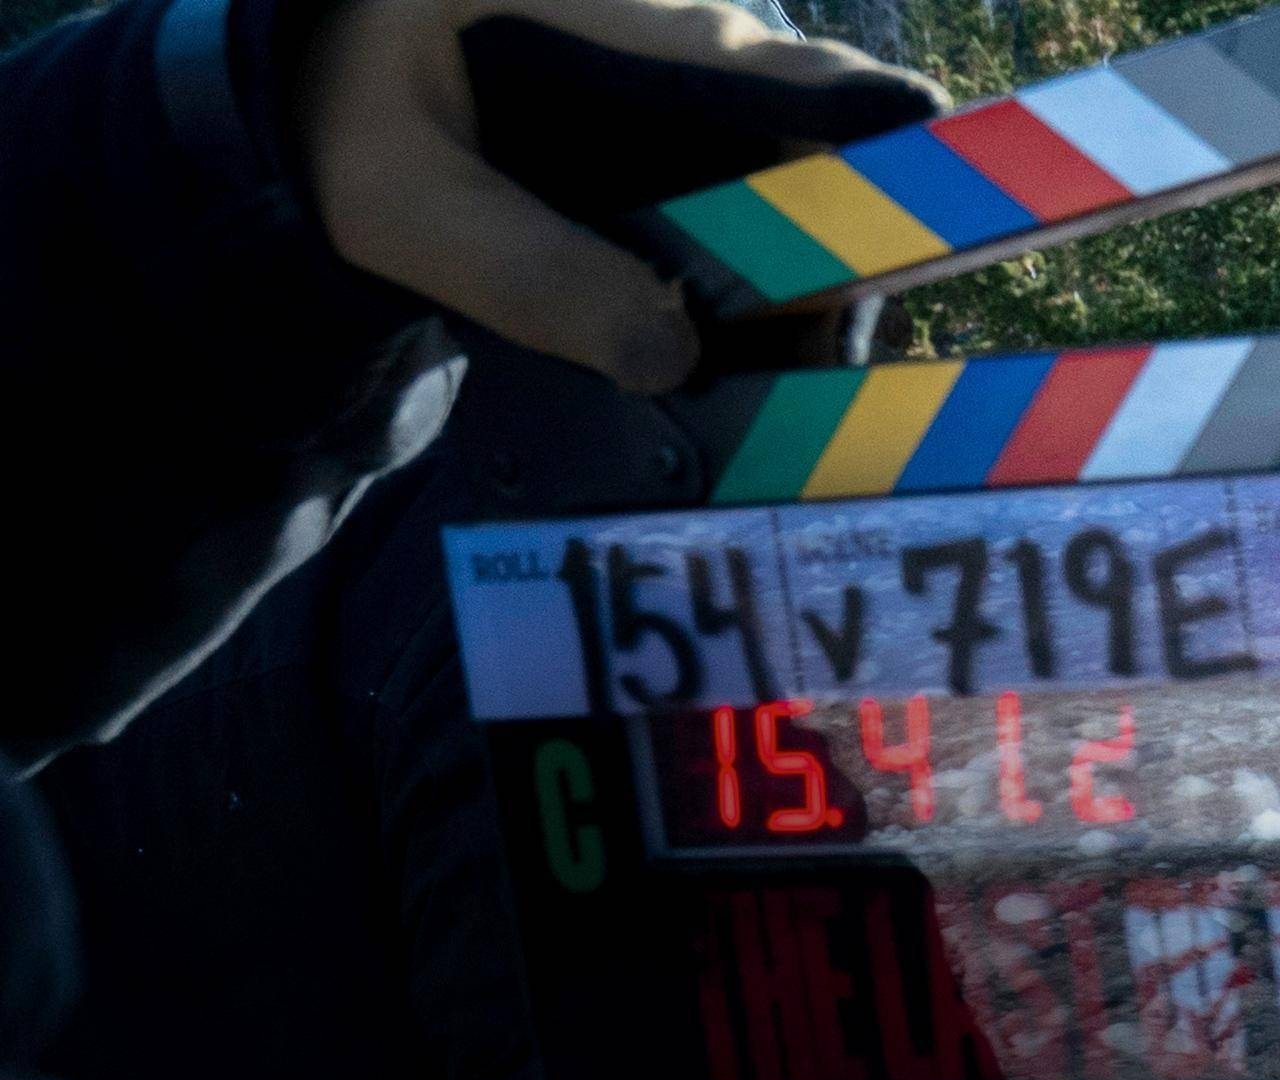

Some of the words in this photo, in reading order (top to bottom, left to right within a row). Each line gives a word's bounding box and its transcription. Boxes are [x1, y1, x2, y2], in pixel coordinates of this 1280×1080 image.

[471, 549, 550, 585] ROLL
[557, 536, 787, 707] 154
[902, 525, 1259, 698] 719E
[532, 736, 608, 895] C
